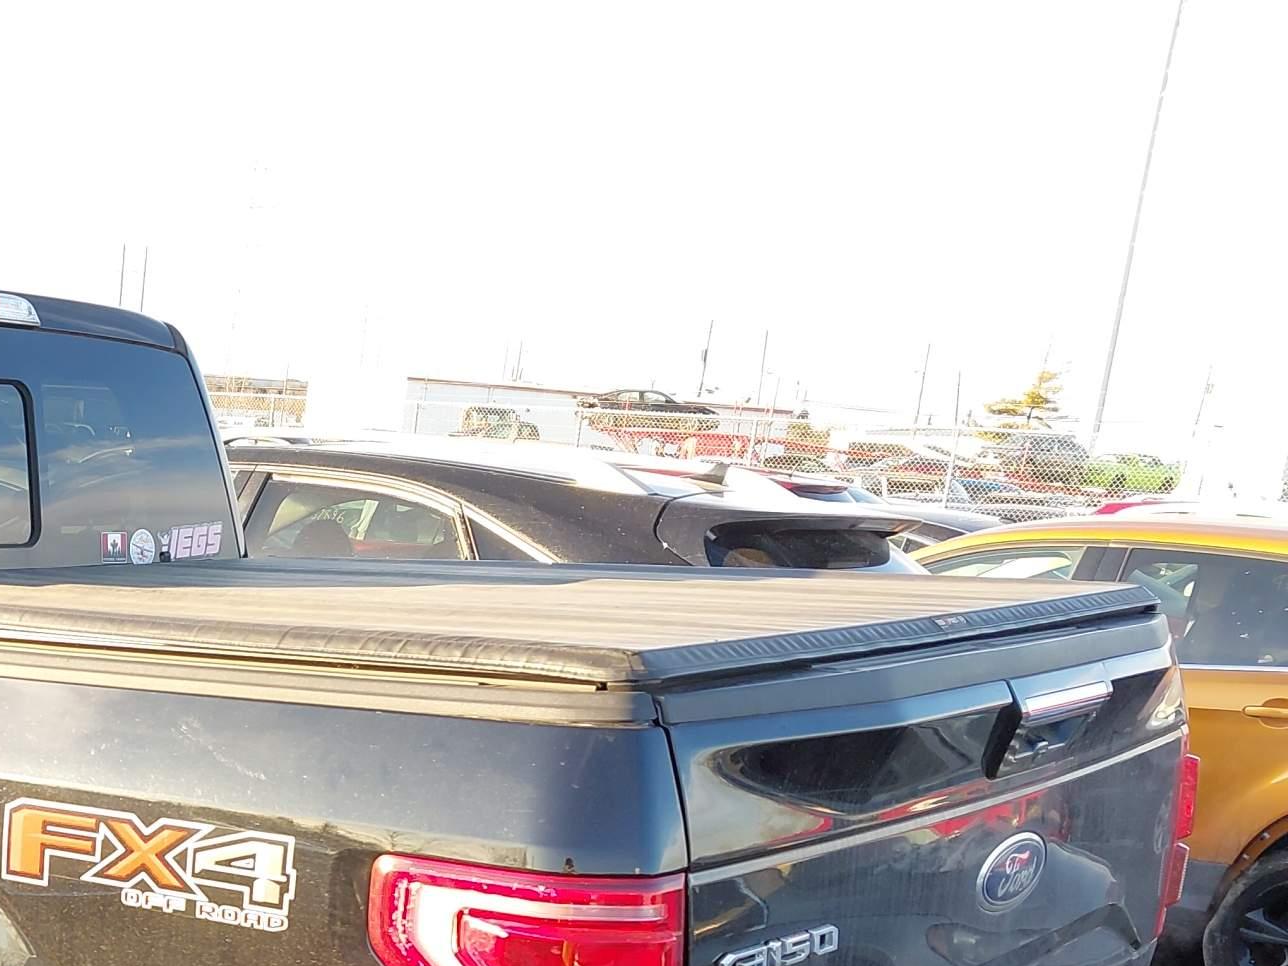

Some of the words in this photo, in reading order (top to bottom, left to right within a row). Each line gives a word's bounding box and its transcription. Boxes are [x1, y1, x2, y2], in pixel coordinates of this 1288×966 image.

[1, 797, 296, 916] FX4
[121, 888, 187, 914] OFF
[196, 900, 289, 932] ROAD
